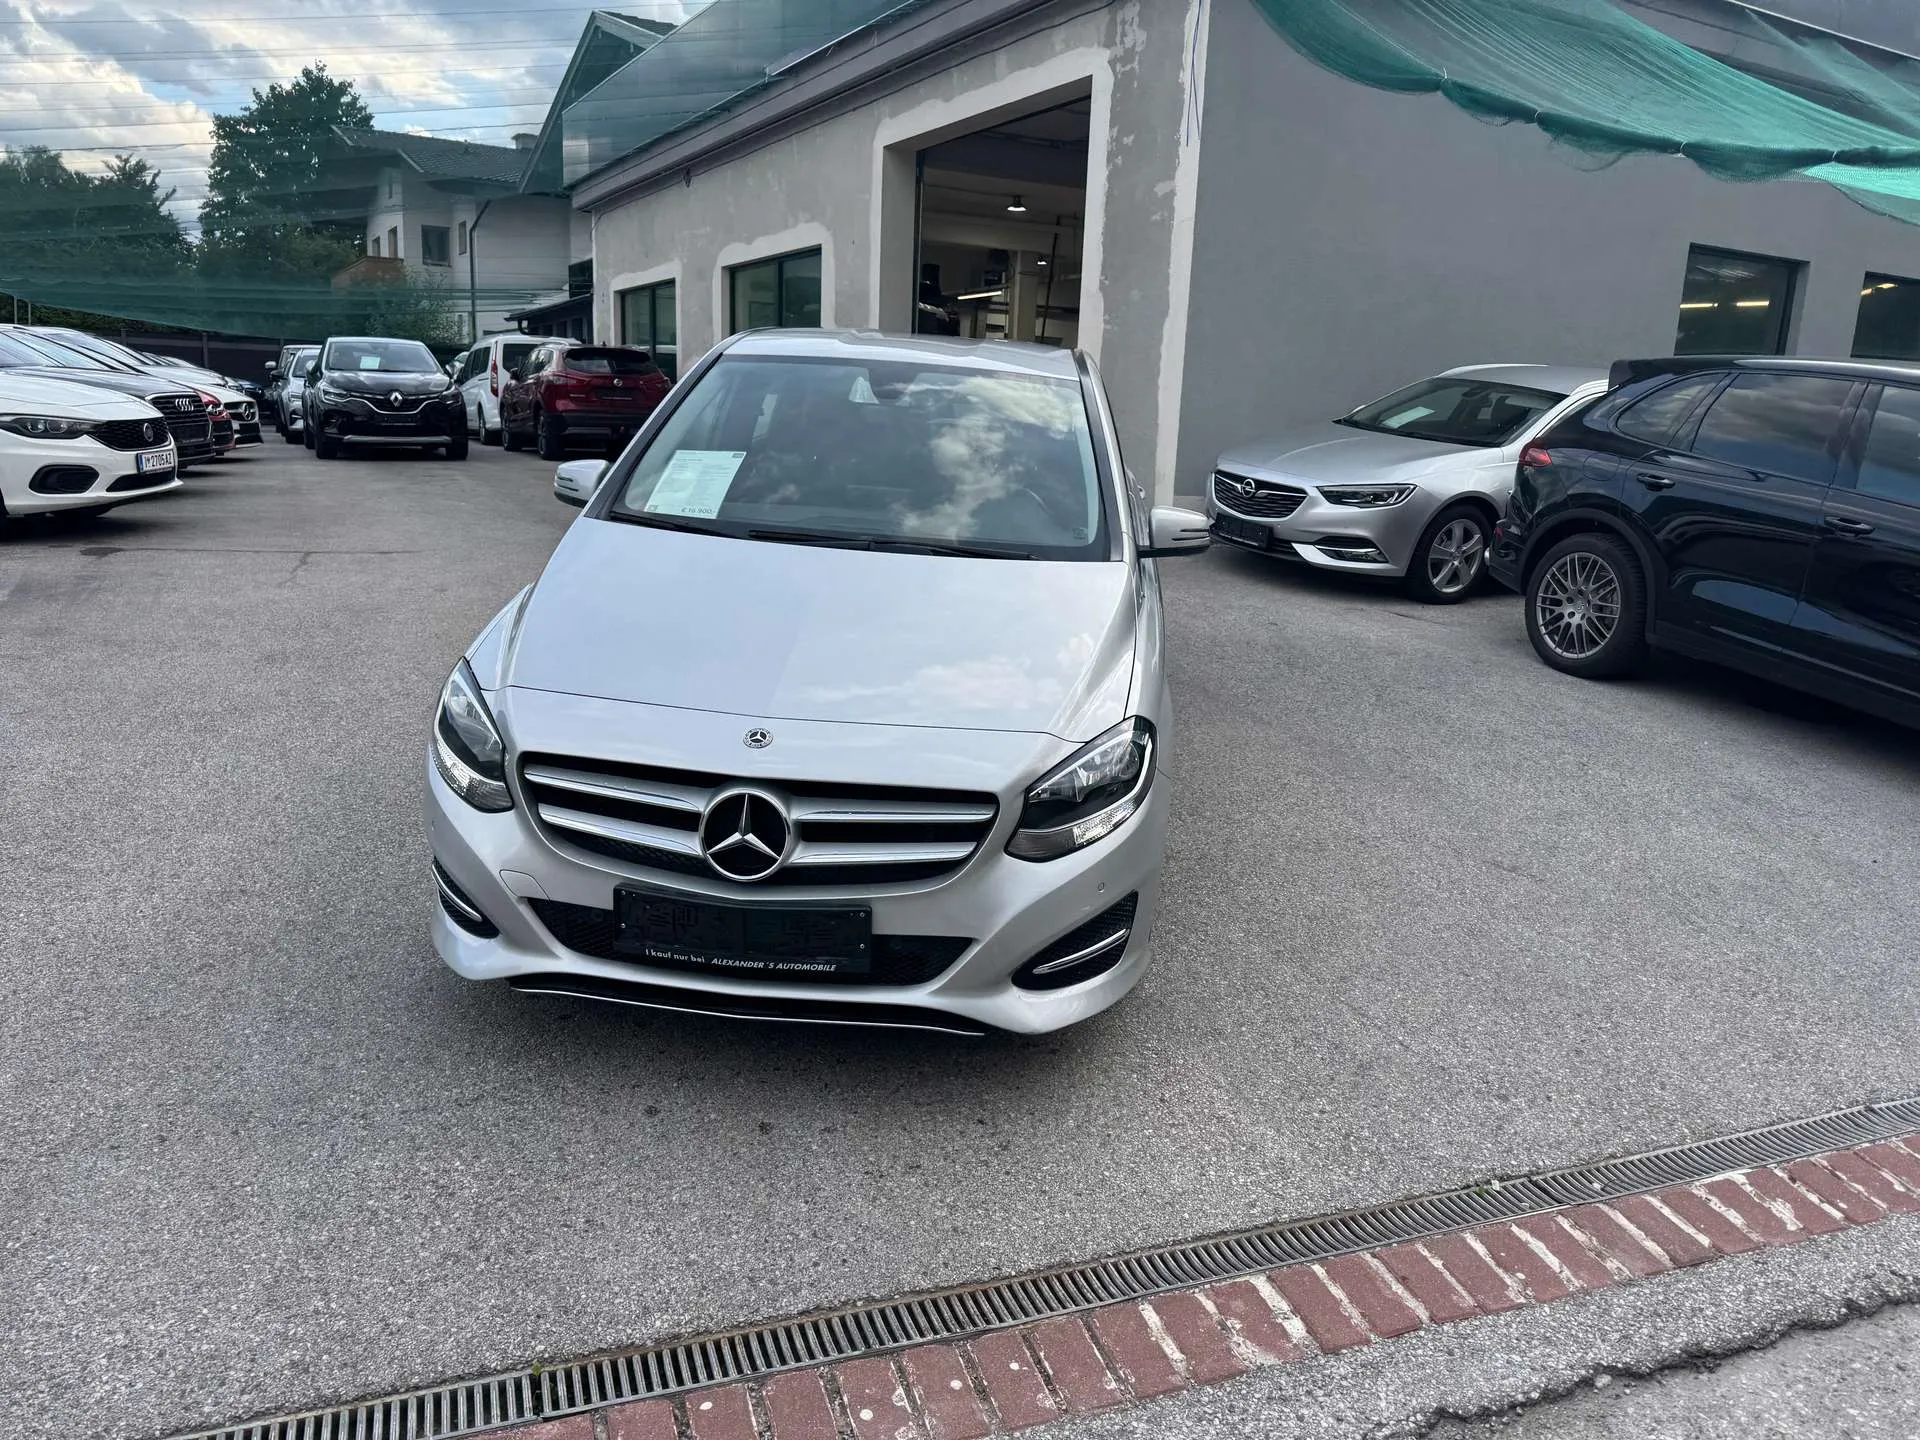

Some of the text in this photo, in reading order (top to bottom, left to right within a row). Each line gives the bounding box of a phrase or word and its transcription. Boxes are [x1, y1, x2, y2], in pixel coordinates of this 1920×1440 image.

[650, 948, 672, 959] kauf
[690, 954, 705, 963] bei
[776, 962, 837, 971] AUTOMOBILE
